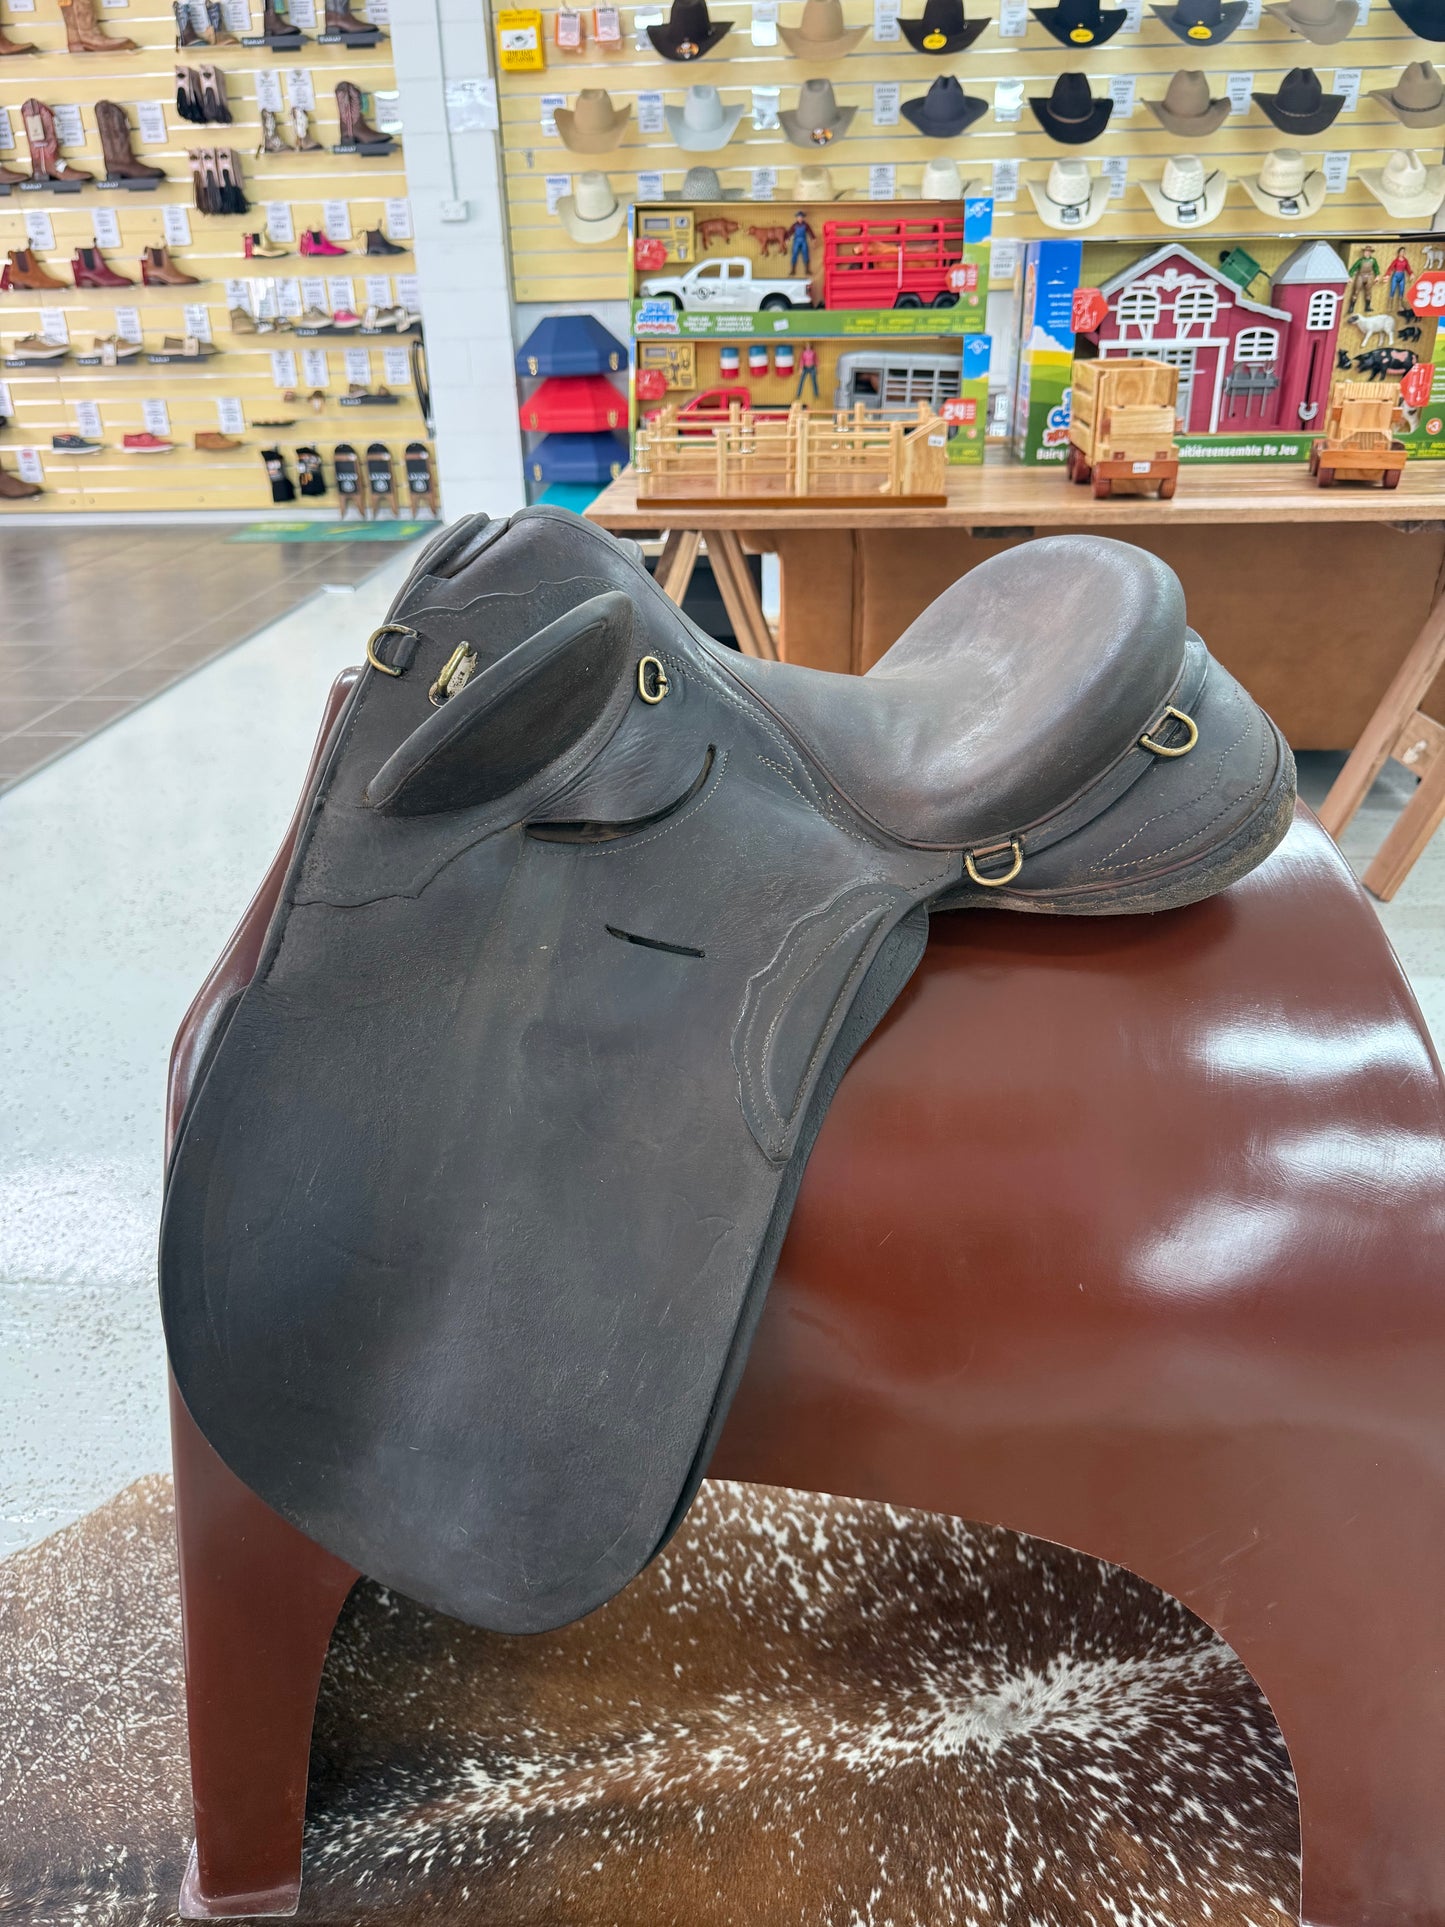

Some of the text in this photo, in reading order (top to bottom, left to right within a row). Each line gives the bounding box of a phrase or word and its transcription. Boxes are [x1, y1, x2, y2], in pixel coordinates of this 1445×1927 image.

[1413, 280, 1445, 308] 38
[943, 403, 965, 420] 24
[1036, 447, 1065, 461] Dairy
[1278, 443, 1299, 456] Jeu
